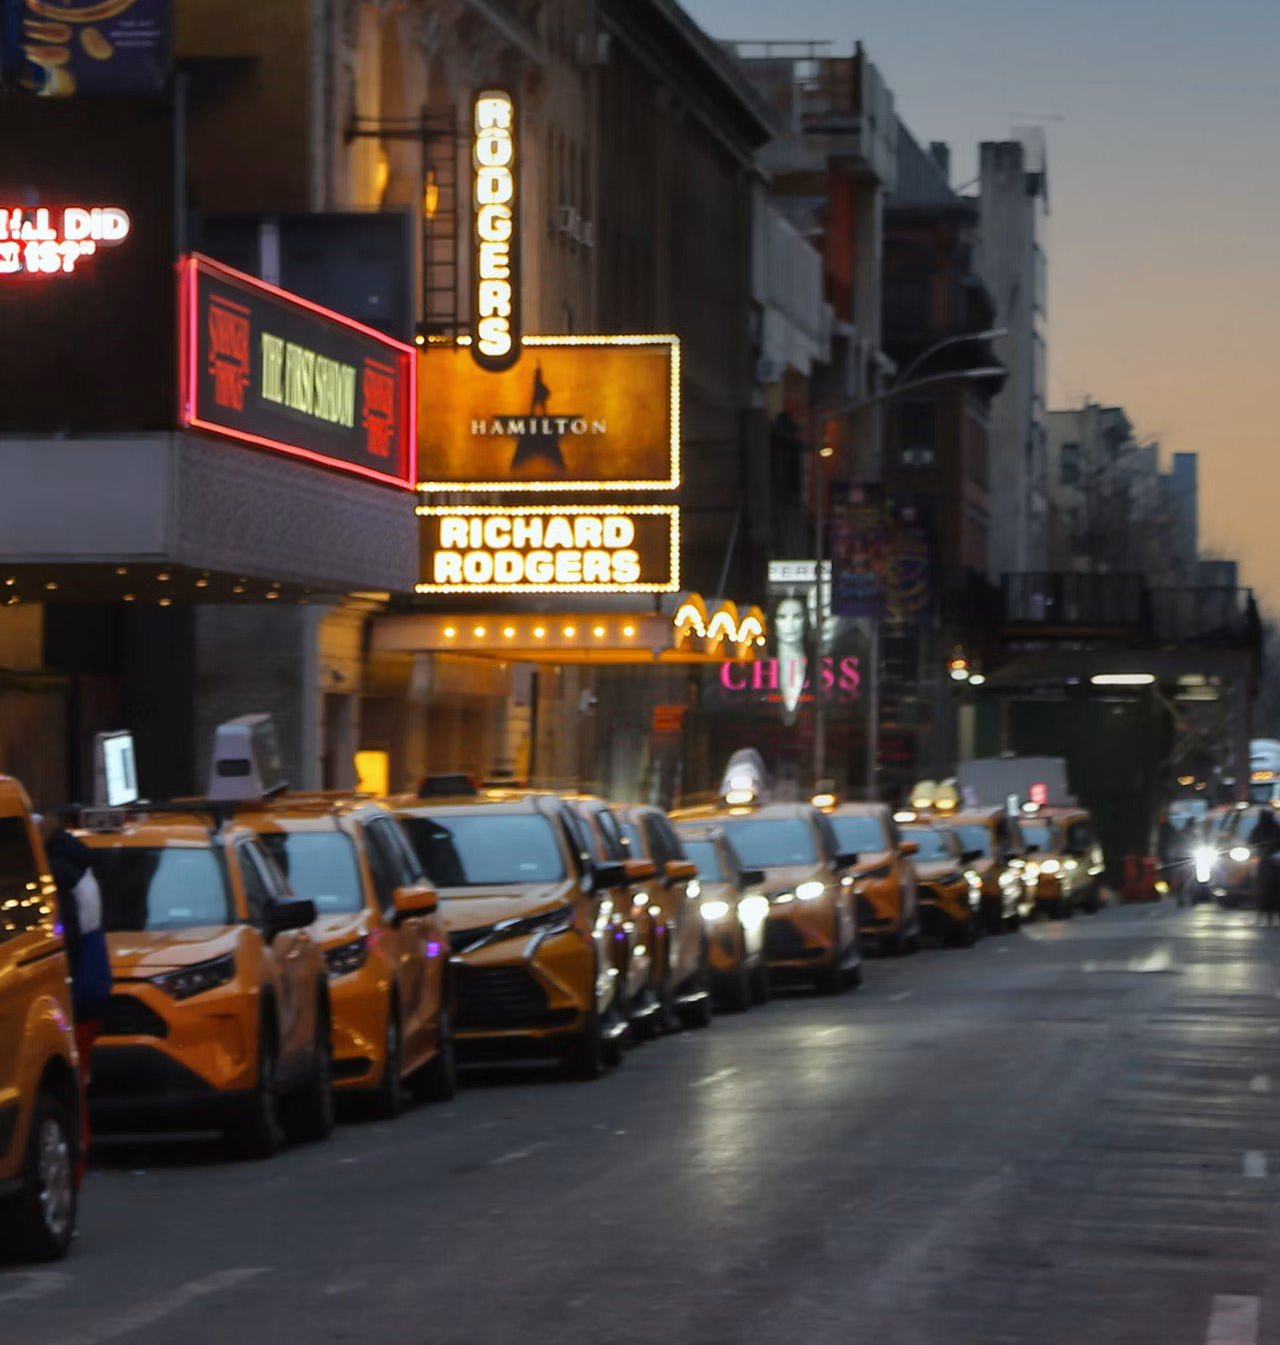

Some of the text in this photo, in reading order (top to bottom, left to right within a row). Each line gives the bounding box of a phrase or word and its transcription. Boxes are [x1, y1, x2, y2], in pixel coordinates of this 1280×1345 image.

[64, 208, 130, 242] DID
[474, 91, 514, 356] RODGERS
[471, 417, 607, 436] HAMILTON
[439, 515, 635, 549] RICHARD
[433, 549, 641, 584] RODGERS
[720, 656, 862, 690] CHESS
